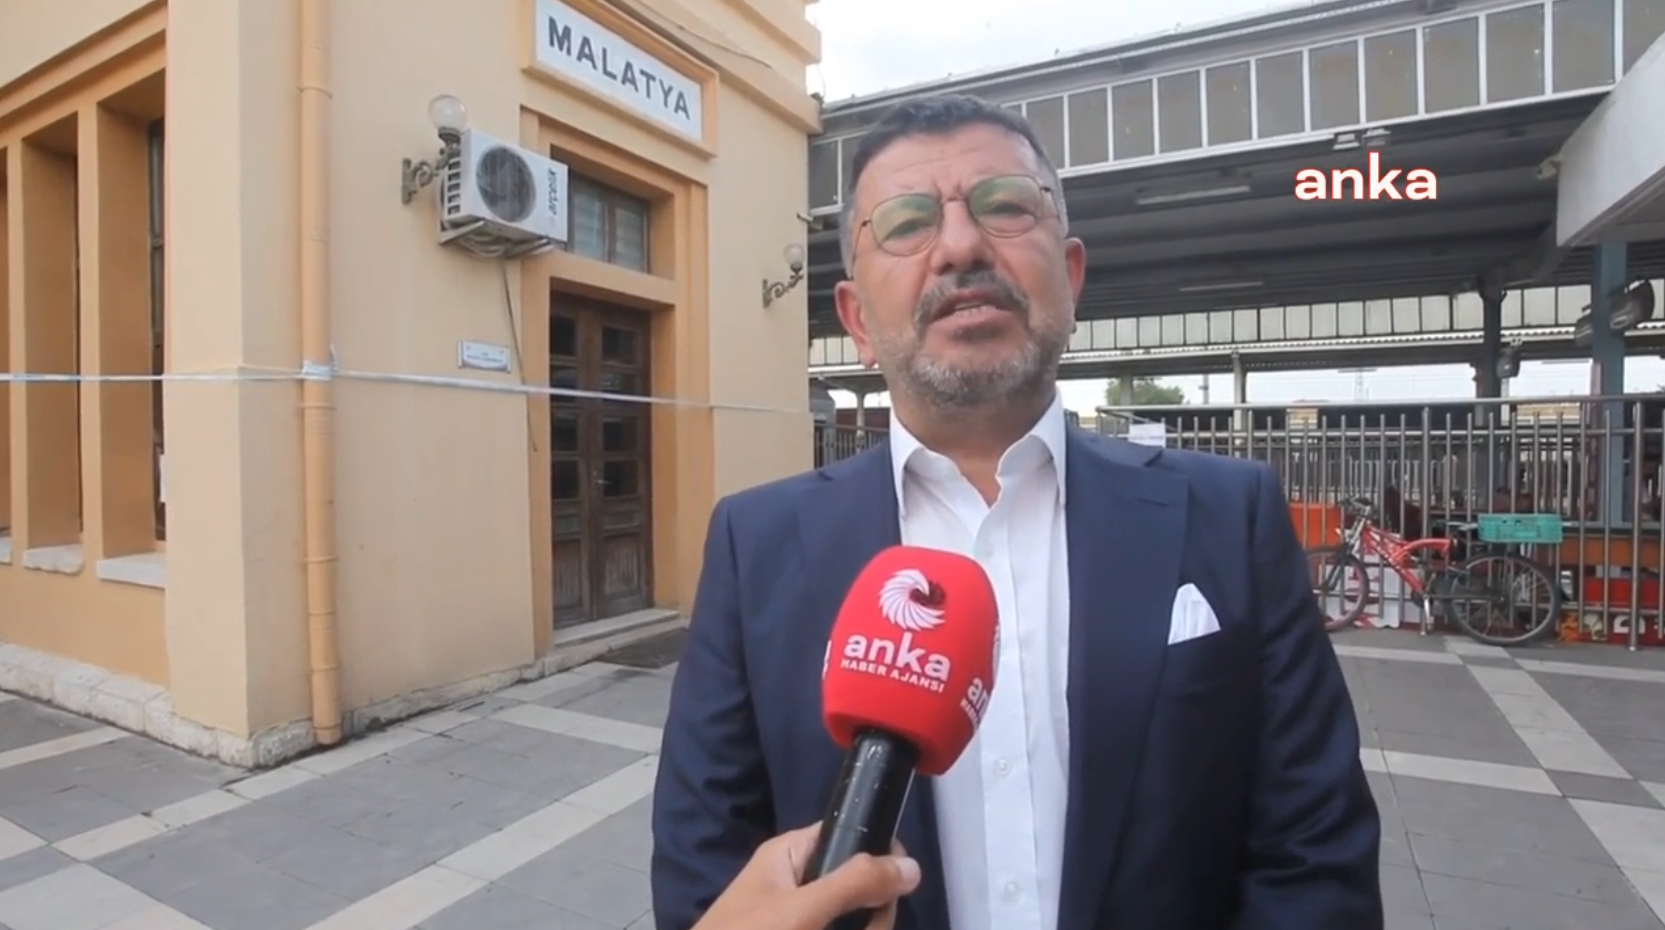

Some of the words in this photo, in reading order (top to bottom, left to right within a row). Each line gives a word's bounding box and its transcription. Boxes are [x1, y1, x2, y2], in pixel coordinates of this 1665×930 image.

[548, 15, 690, 121] MALATYA
[840, 658, 887, 677] HABER
[889, 668, 945, 693] AJANSI
[843, 631, 952, 682] anka
